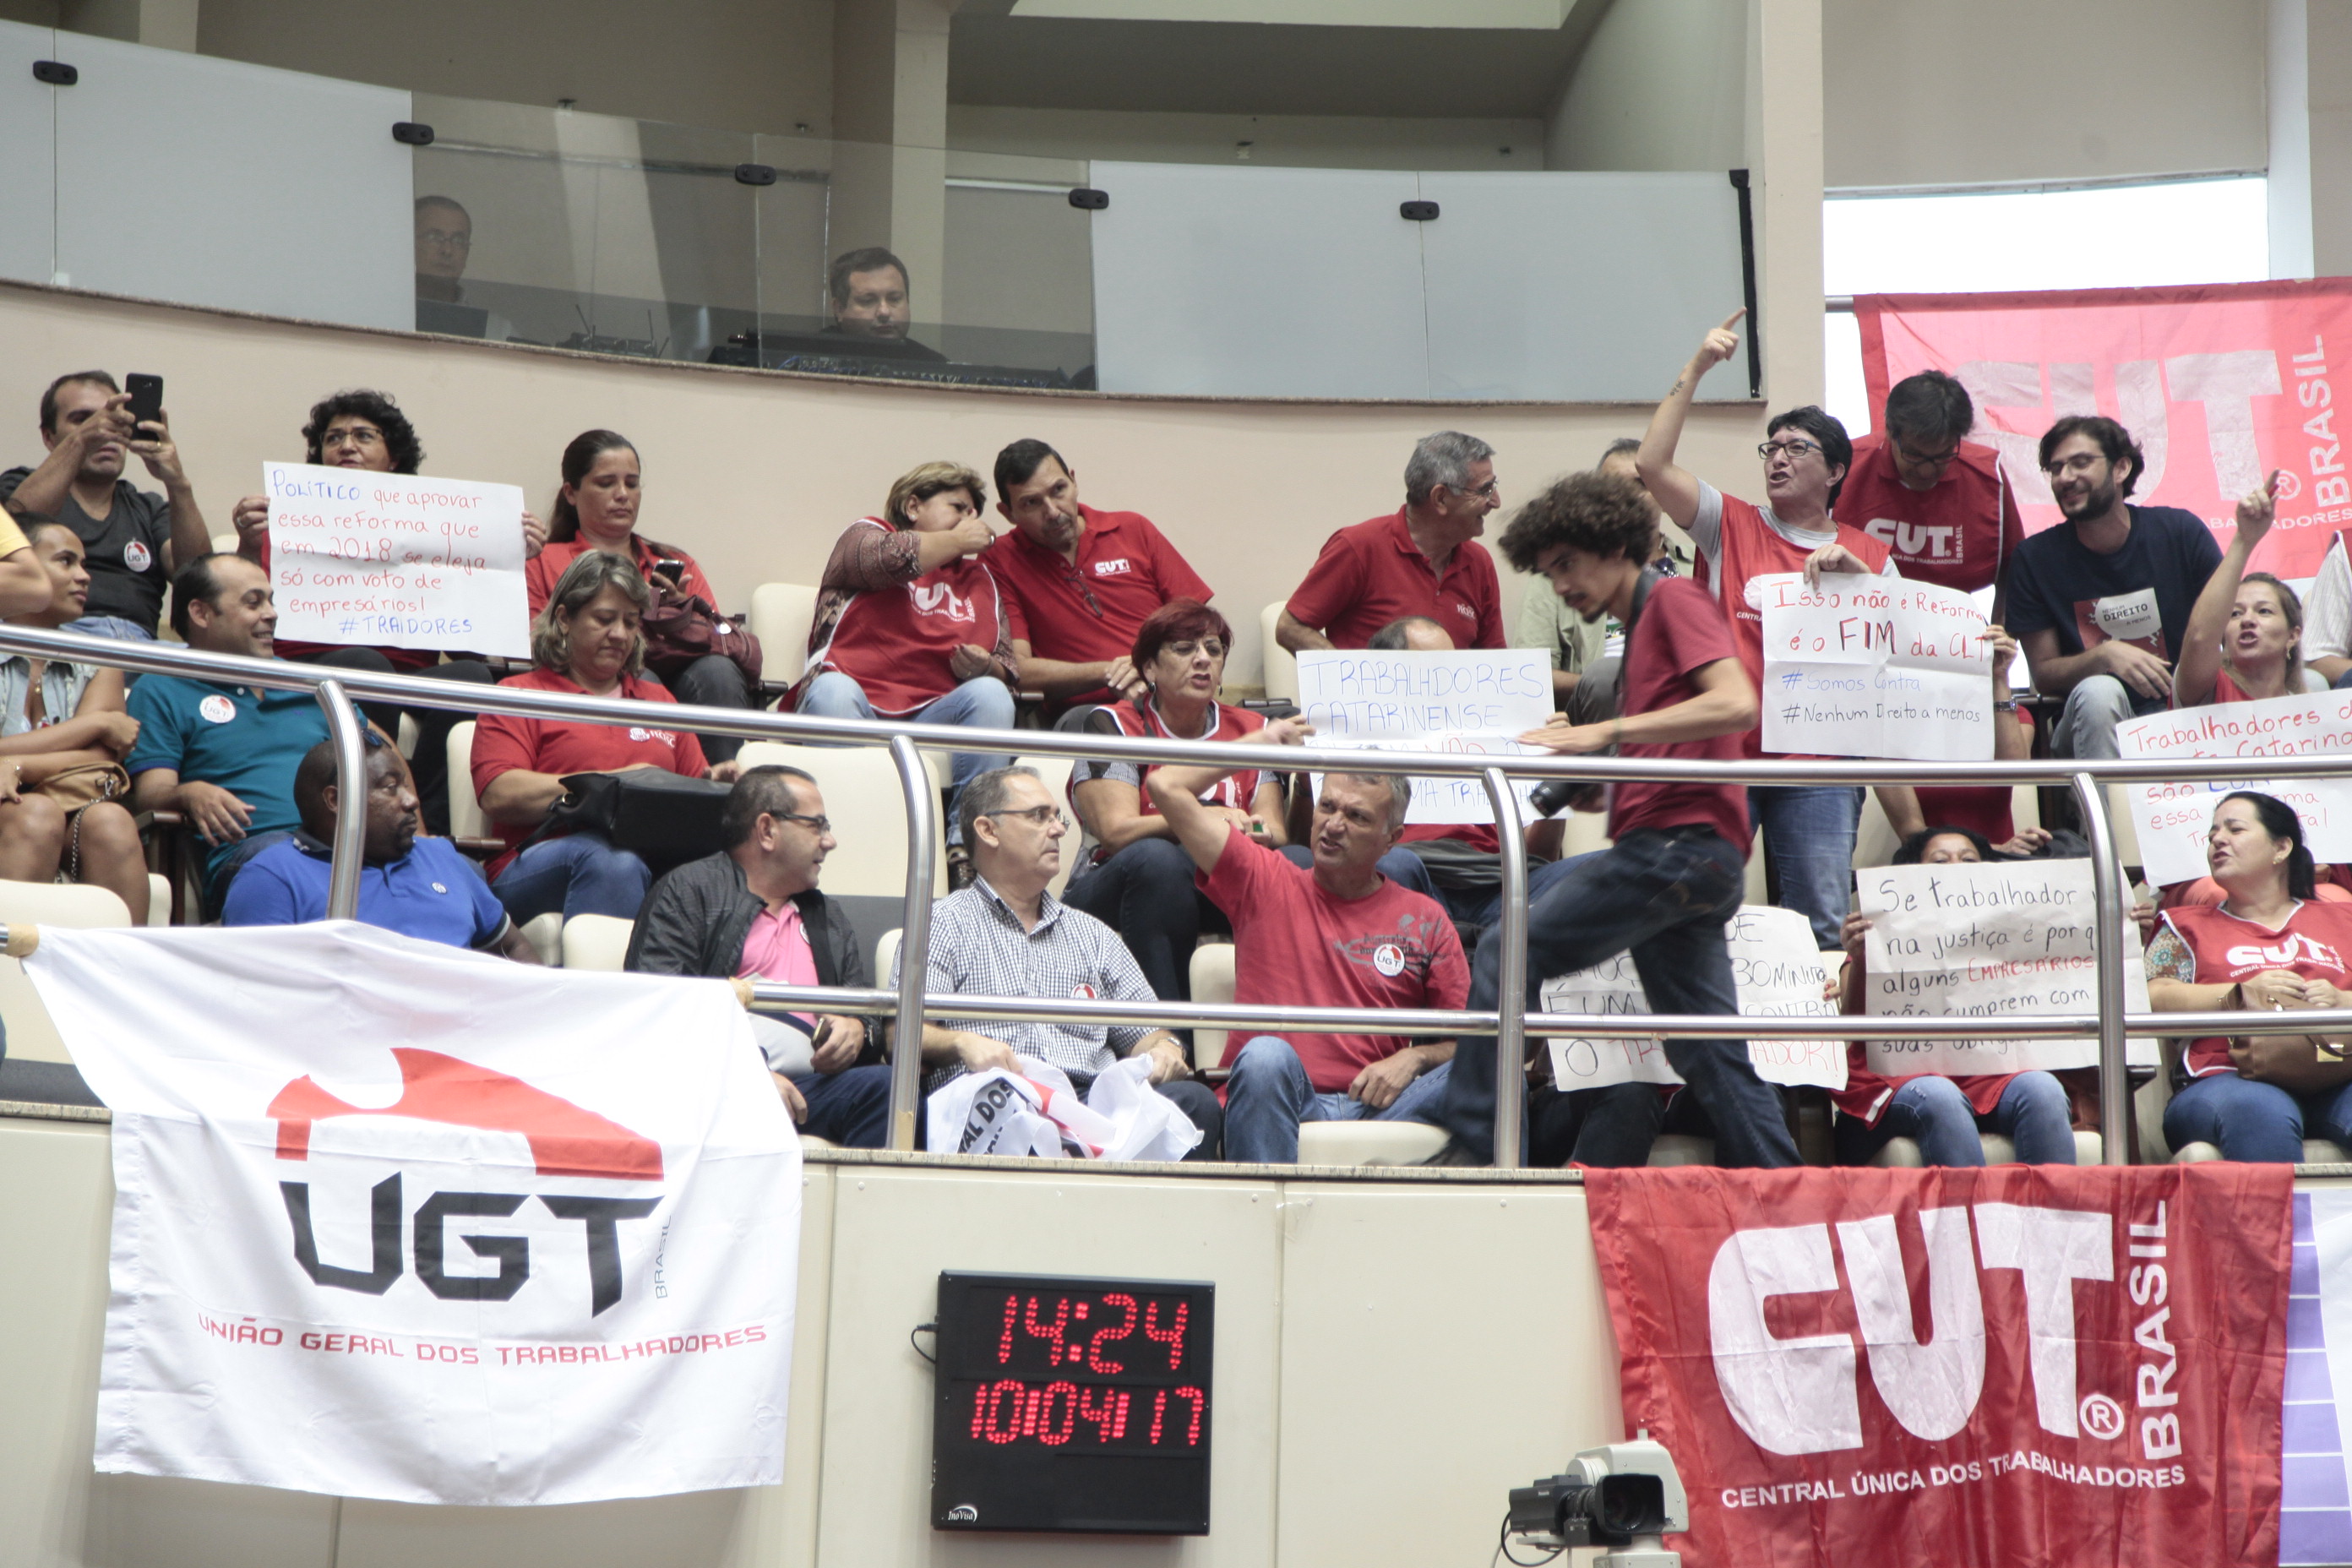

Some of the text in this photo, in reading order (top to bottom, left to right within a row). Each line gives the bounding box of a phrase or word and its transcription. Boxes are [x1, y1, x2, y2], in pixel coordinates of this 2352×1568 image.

[2292, 335, 2352, 507] BRASIL
[373, 488, 400, 511] que
[406, 492, 483, 512] aprovar
[277, 512, 325, 528] essa
[439, 520, 480, 547] que
[1864, 518, 1953, 558] CUT
[1956, 524, 1964, 559] BRASIL
[280, 536, 487, 576] em 2018 se eleja
[1095, 558, 1126, 574] CUT
[280, 567, 443, 591] só com voto de
[1769, 580, 1841, 609] Isso
[1853, 589, 1891, 609] não
[1899, 592, 1908, 611] é
[2104, 603, 2148, 623] DIREITO
[1788, 616, 1986, 663] é o FIM da CLT
[1921, 707, 1931, 720] a
[1935, 705, 1981, 724] menos
[2127, 710, 2321, 753] Trabalhadores
[2150, 808, 2203, 830] essa
[1879, 876, 2078, 912] Se trabalhador
[1886, 937, 1922, 956] na
[1932, 922, 2011, 961] justiça
[2023, 923, 2034, 943] é
[2226, 933, 2328, 966] CUT
[1377, 956, 1399, 968] UGT
[2230, 964, 2260, 977] CENTRAL
[1882, 967, 1960, 997] alguns
[2050, 988, 2090, 1004] com
[278, 1171, 666, 1320] UGT
[654, 1213, 672, 1299] BRASIL
[198, 1311, 767, 1366] UNIÃO GERAL DOS TRABALHADORES
[998, 1293, 1189, 1375] 14:24
[1708, 1202, 2115, 1456] CUT
[2128, 1200, 2183, 1461] BRASIL
[1721, 1449, 2186, 1509] CENTRAL ÚNICA DOS TRABALHADORES
